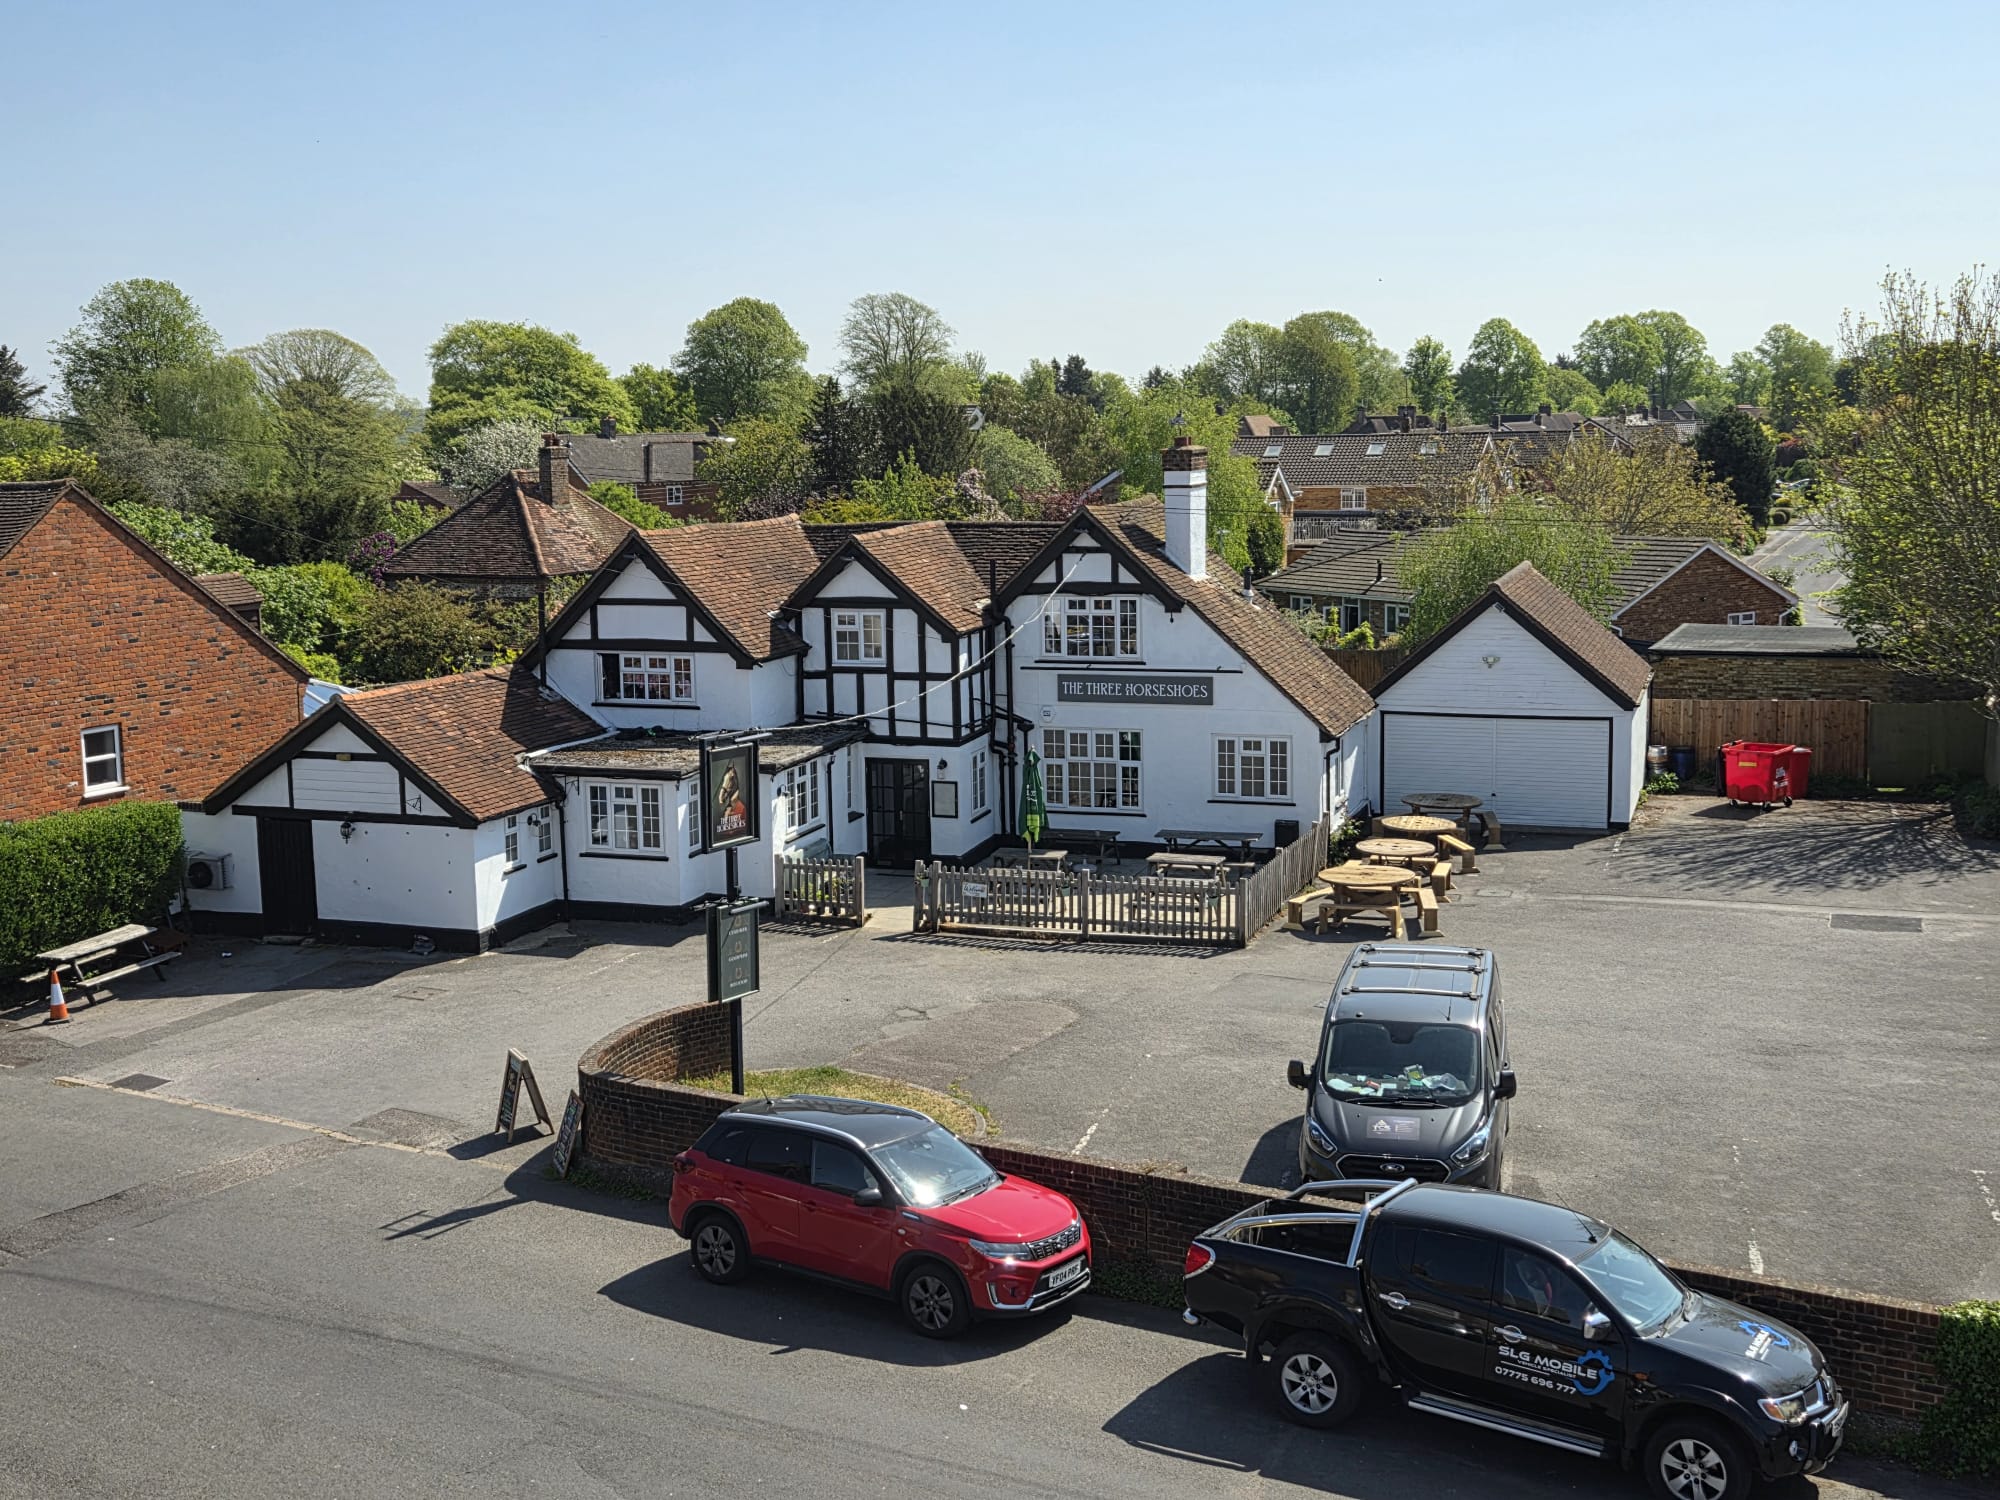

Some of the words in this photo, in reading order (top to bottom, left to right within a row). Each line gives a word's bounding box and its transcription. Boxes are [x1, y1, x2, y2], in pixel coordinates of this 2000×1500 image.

[1062, 681, 1083, 695] THE
[1086, 682, 1122, 696] THREE
[1125, 683, 1208, 698] HORSESHOES
[1498, 1345, 1530, 1362] SLG
[1534, 1355, 1597, 1379] MOBILE
[1517, 1359, 1541, 1370] VEHICLE
[1494, 1366, 1529, 1382] 07775
[1530, 1376, 1554, 1389] 696
[1556, 1383, 1577, 1395] 777
